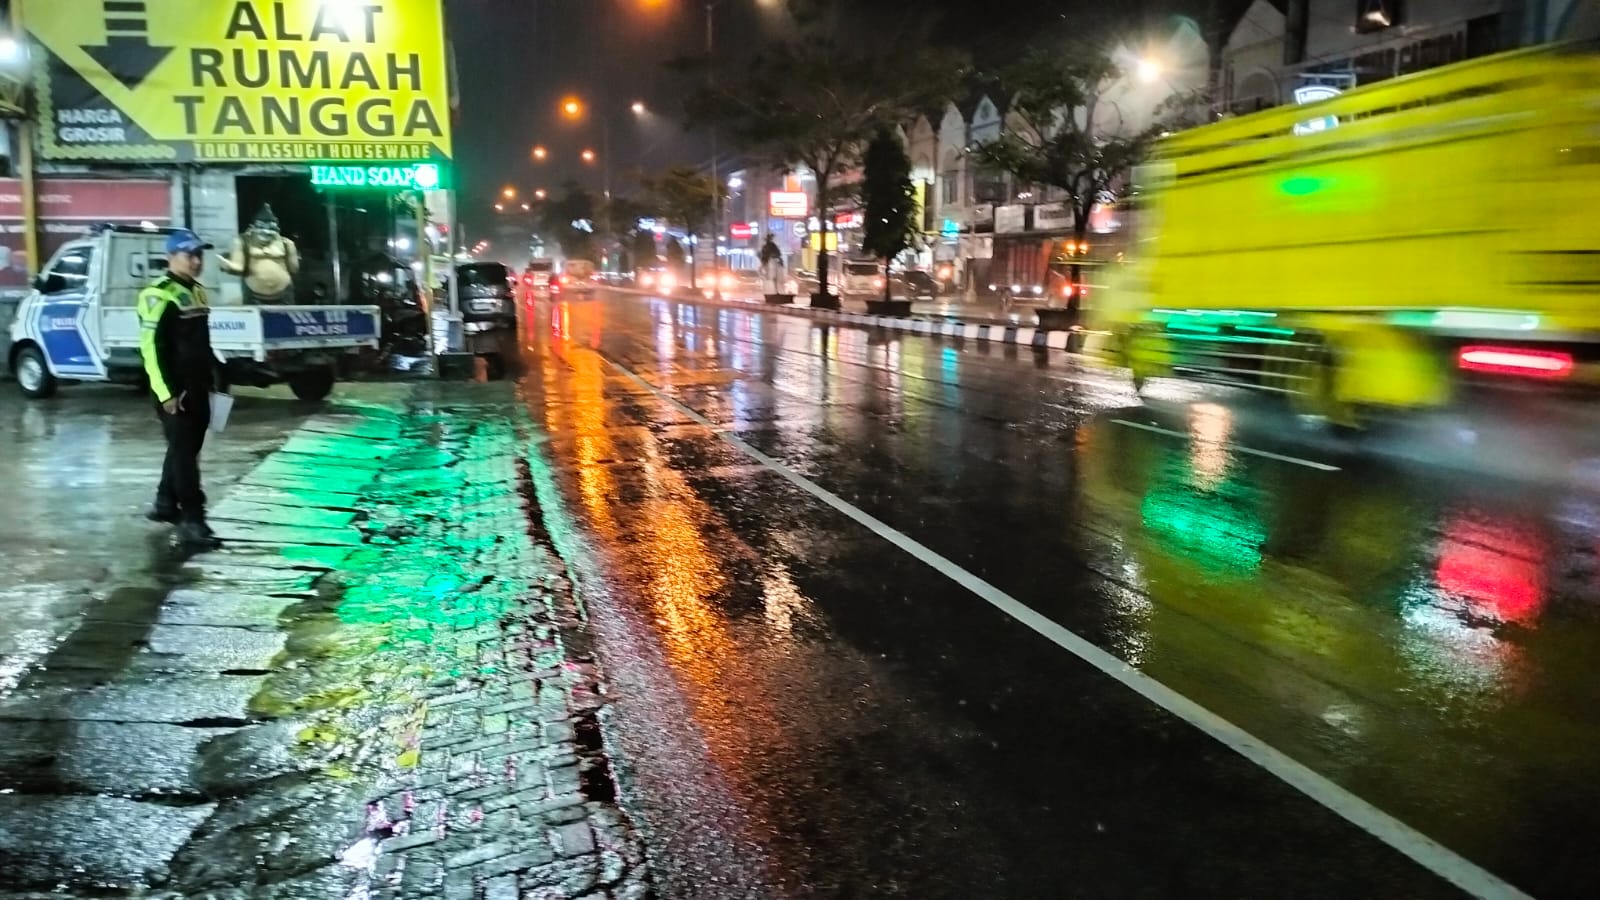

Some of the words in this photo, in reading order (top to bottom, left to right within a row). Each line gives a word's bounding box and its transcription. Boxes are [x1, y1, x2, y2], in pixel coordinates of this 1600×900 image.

[225, 0, 384, 43] ALAT
[190, 48, 421, 91] RUMAH
[58, 109, 122, 124] HARGA
[174, 95, 443, 137] TANGGA
[59, 127, 126, 142] GROSIR
[194, 143, 240, 158] TOKO
[248, 143, 323, 158] MASSUGI
[329, 144, 431, 159] HOUSEWARE
[311, 166, 364, 185] HAND
[368, 167, 415, 186] SOAP
[296, 325, 348, 335] POLISI
